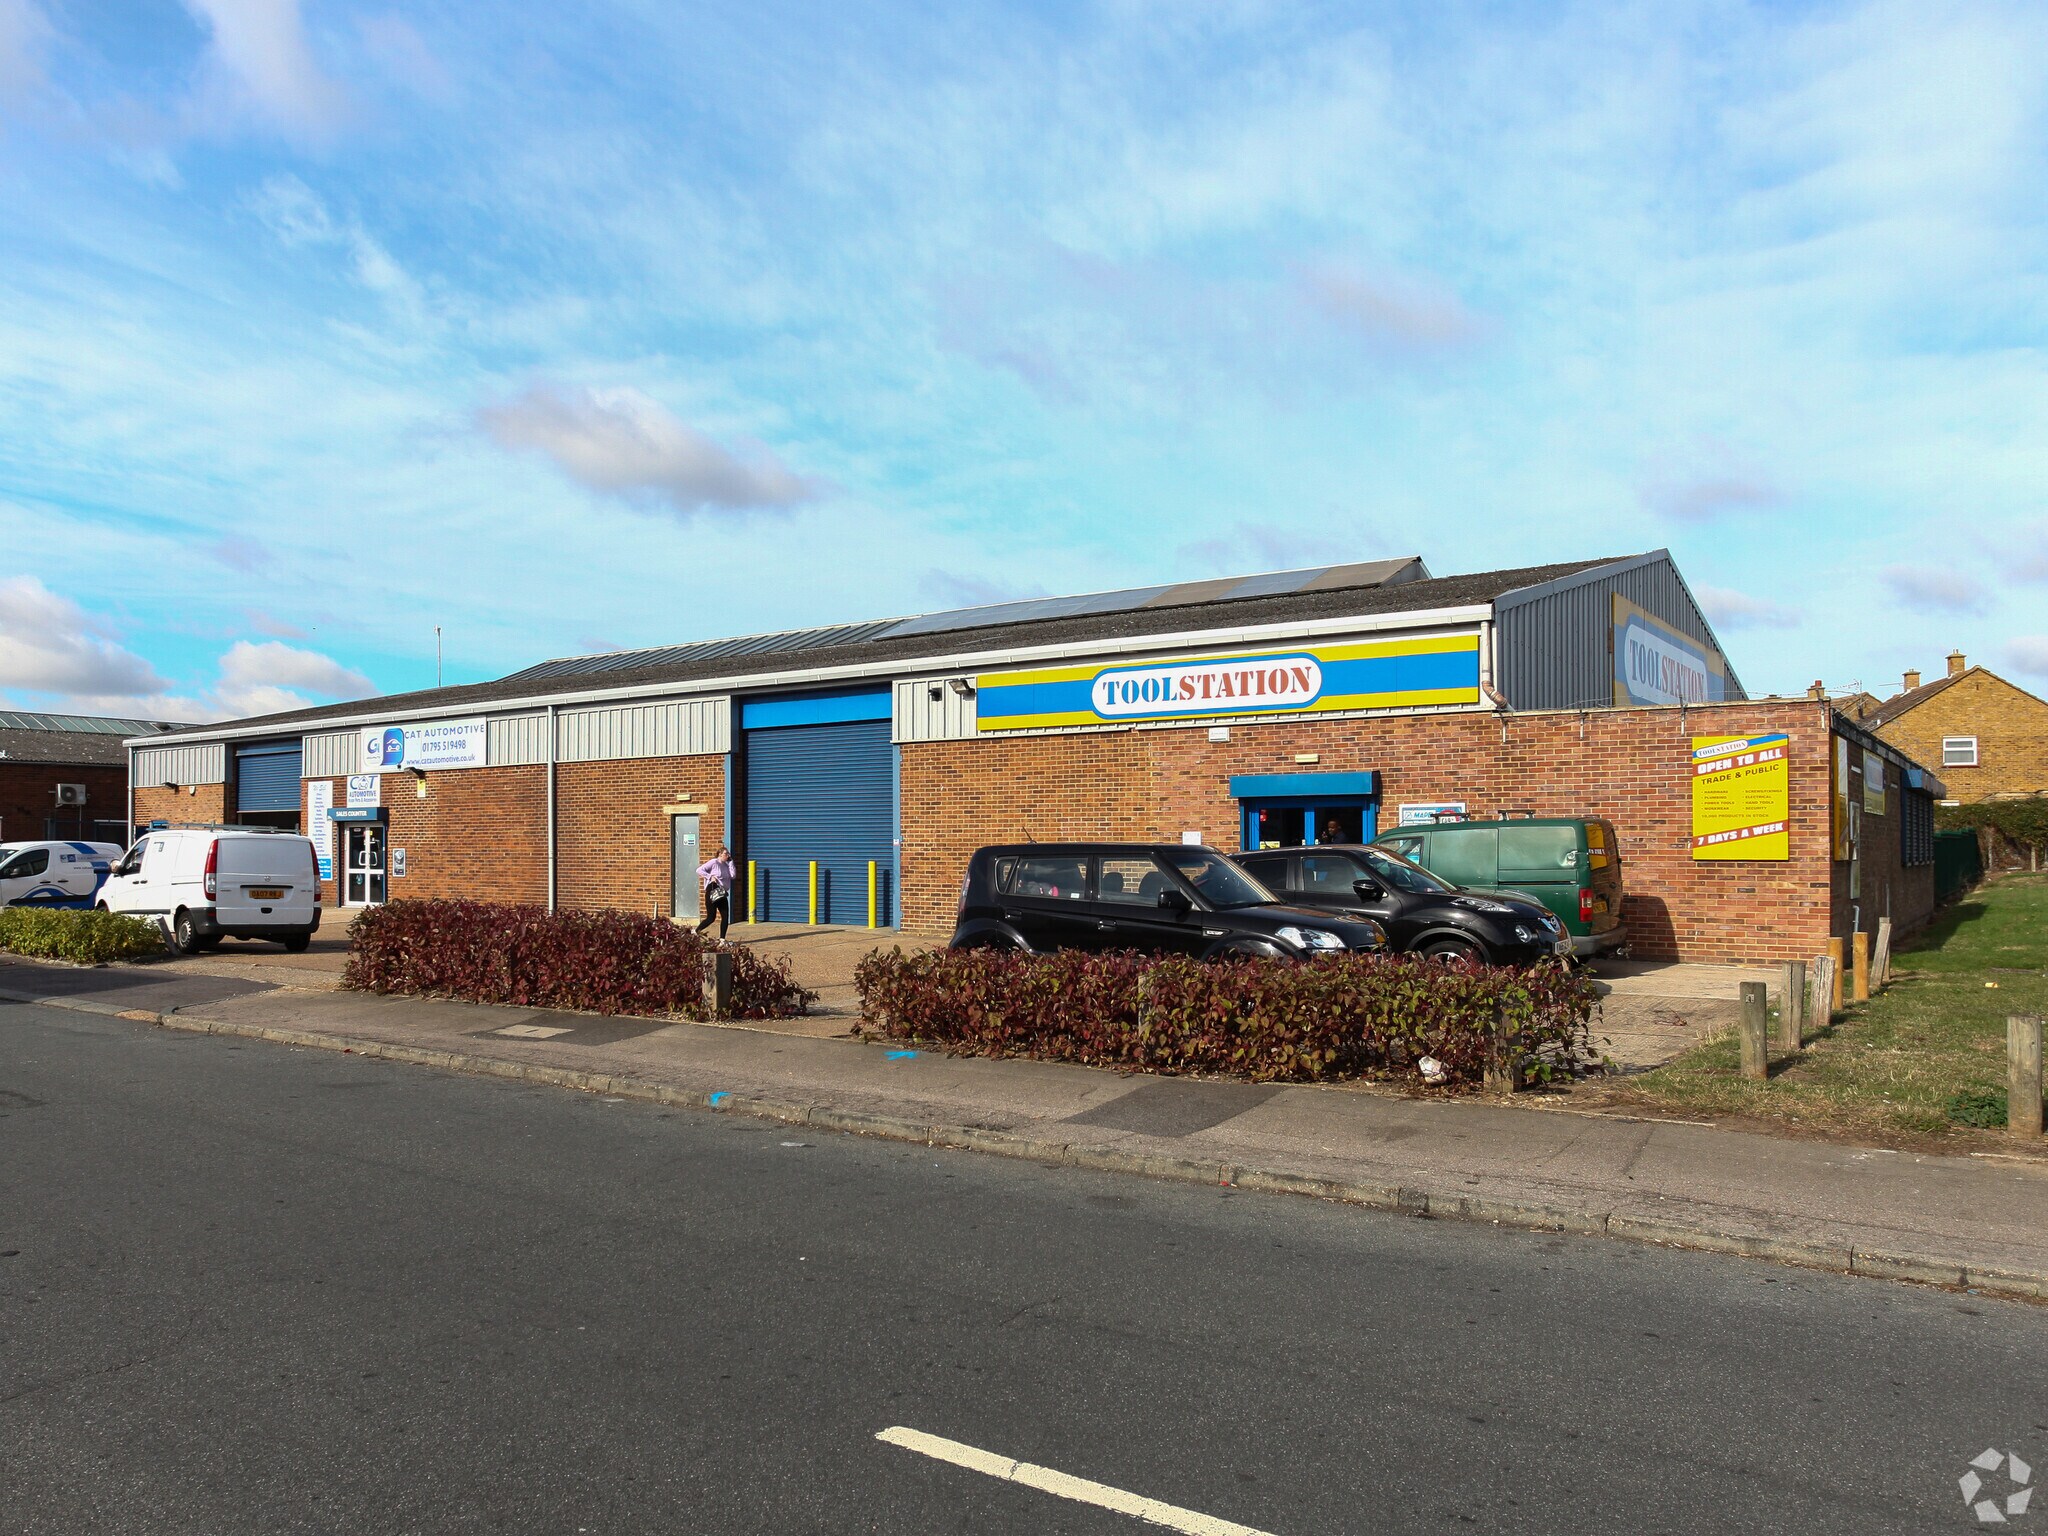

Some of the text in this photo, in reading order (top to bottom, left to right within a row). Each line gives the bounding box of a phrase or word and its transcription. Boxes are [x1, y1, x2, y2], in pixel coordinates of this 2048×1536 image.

[1630, 639, 1704, 704] TOOLSTATION
[1103, 666, 1312, 706] TOOLSTATION
[404, 724, 485, 740] CAT AUTOMOTIVE
[422, 739, 467, 753] 01795 519498
[1698, 741, 1747, 757] TOOLSTATION
[406, 753, 476, 766] www.catautomotive.co.uk
[1697, 748, 1782, 775] OPEN TO ALL
[1701, 763, 1780, 786] TRADE & PUBLIC
[349, 790, 377, 798] AUTOMOTIVE
[1698, 822, 1784, 846] 7 DAYS A WEEK
